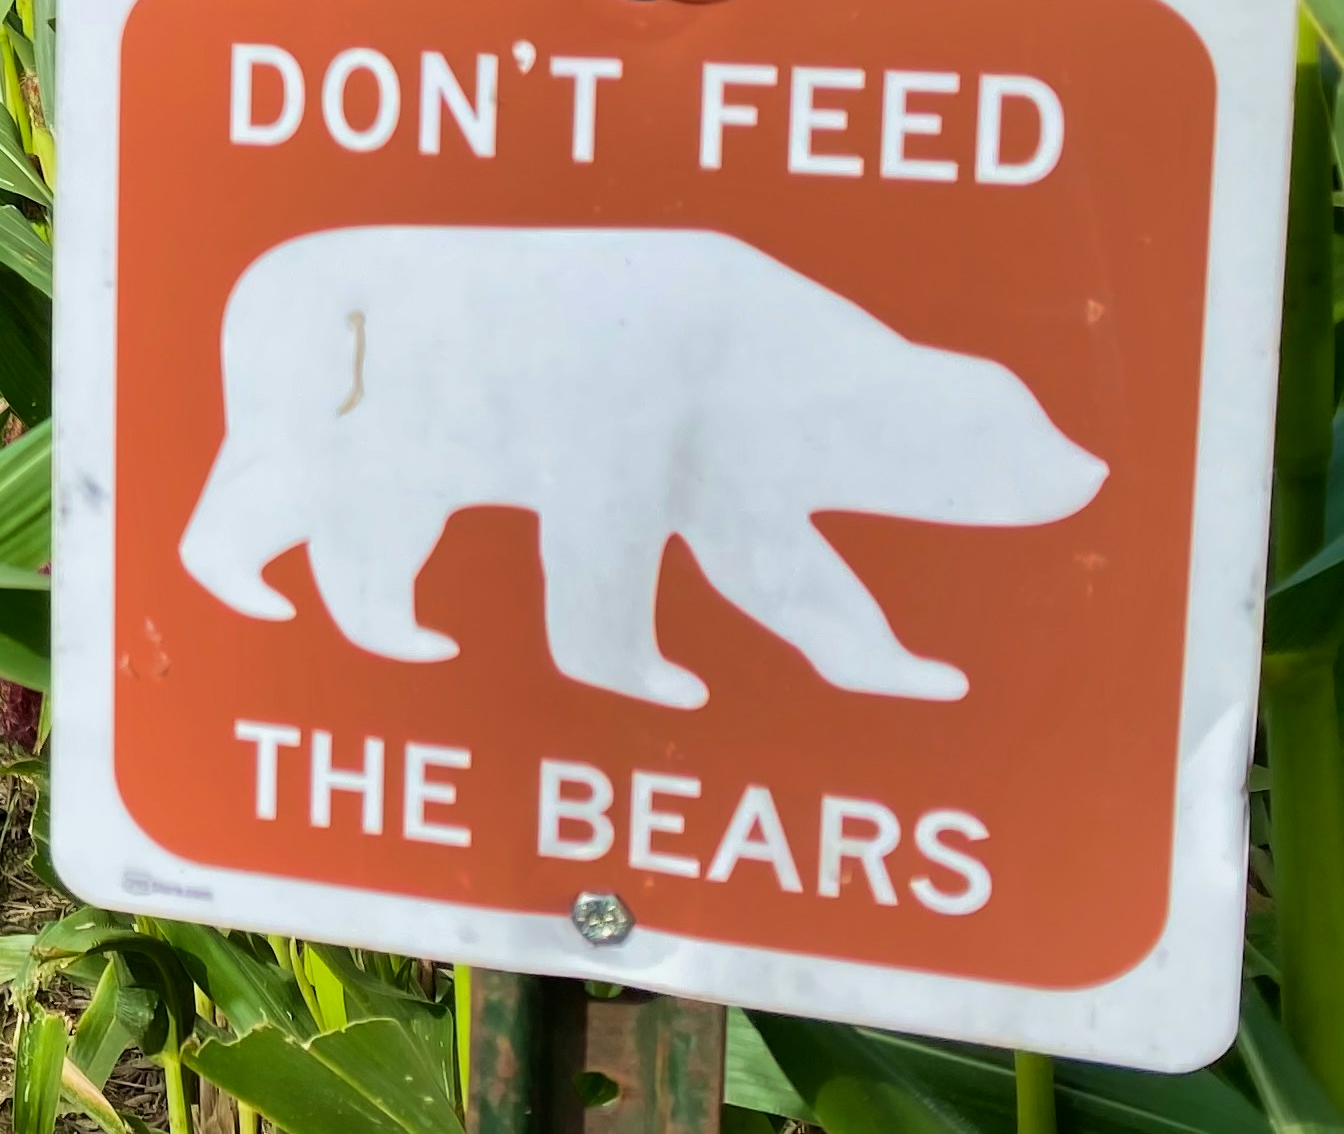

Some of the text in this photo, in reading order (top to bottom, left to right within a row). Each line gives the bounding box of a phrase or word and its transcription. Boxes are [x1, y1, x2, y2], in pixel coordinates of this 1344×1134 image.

[228, 39, 1066, 187] DON'T FEED
[233, 719, 994, 917] THE BEARS
